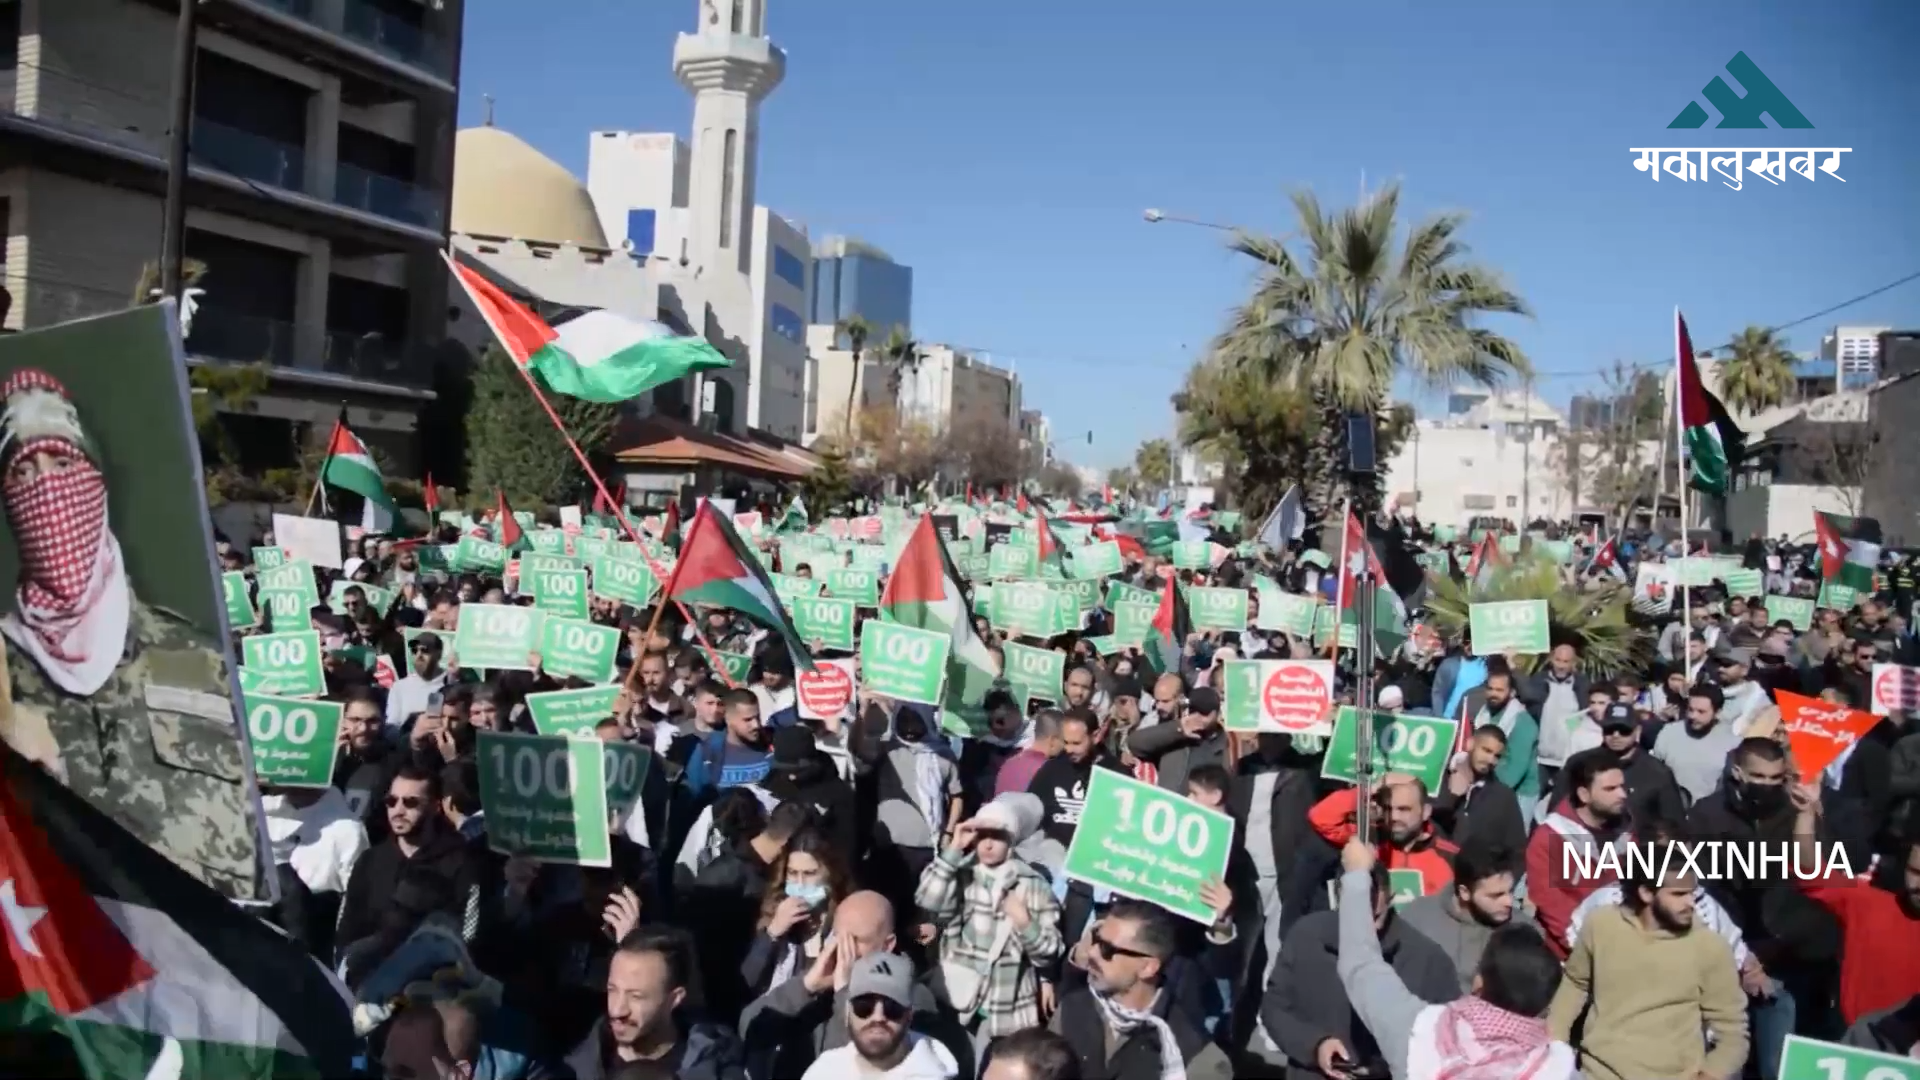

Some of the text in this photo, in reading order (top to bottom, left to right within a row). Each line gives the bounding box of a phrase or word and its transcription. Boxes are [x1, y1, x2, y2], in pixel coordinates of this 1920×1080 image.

[541, 574, 577, 597] 100
[604, 559, 641, 586] 100
[835, 571, 869, 589] 100
[1200, 591, 1238, 609] 100
[1774, 600, 1806, 614] 100
[472, 610, 532, 638] 100
[803, 603, 843, 626] 100
[1486, 607, 1535, 626] 100
[254, 638, 308, 668] 100
[554, 623, 606, 656] 100
[873, 628, 932, 666] 100
[1012, 648, 1055, 676] 100
[250, 703, 318, 744] 00
[1380, 721, 1437, 757] 00
[491, 744, 579, 799] 100
[1111, 787, 1210, 859] 100
